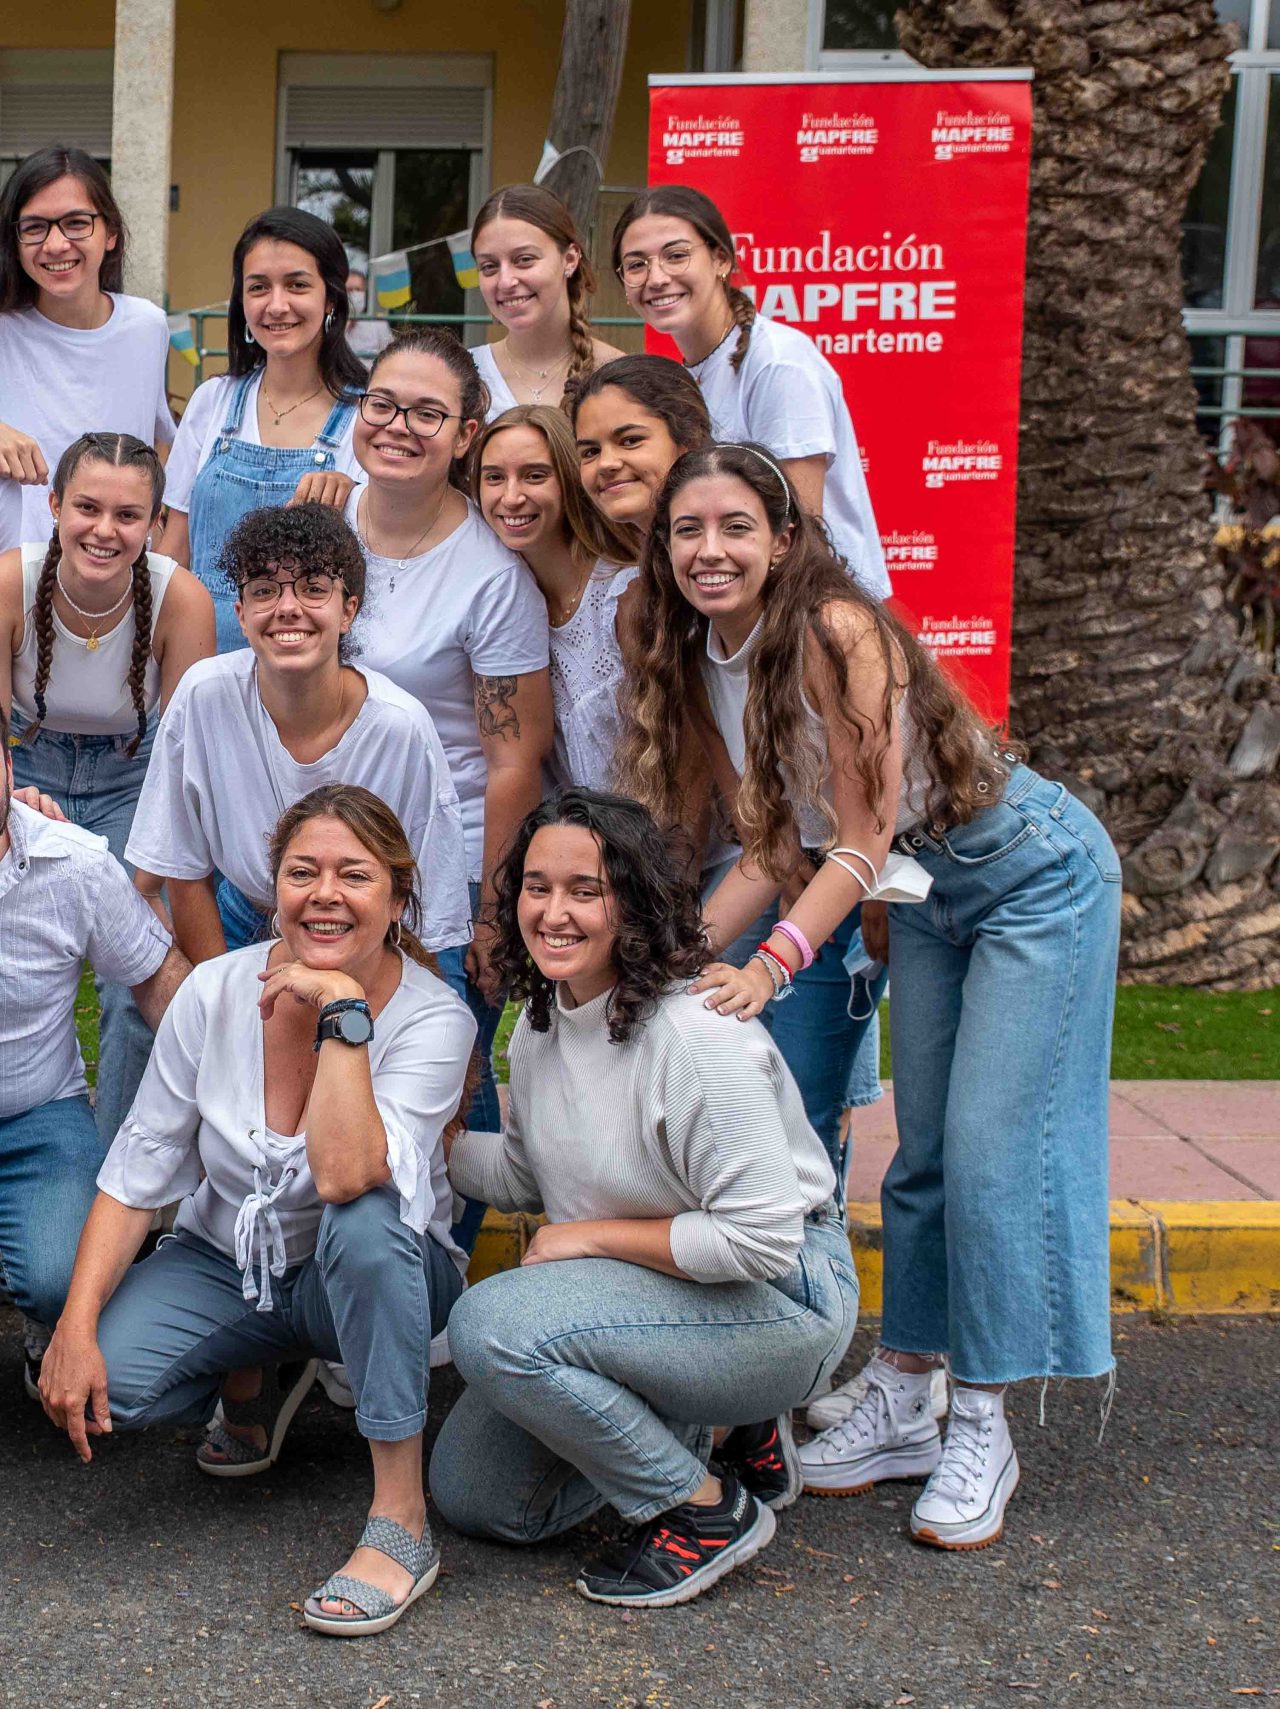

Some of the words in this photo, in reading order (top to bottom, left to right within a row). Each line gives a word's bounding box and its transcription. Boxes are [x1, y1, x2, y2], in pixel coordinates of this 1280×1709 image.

[667, 114, 740, 131] Fundación
[801, 113, 875, 129] Fundación
[936, 110, 1010, 127] Fundación
[662, 131, 744, 147] MAPFRE
[796, 128, 878, 145] MAPFRE
[931, 126, 1014, 143] MAPFRE
[731, 230, 945, 274] Fundación
[815, 328, 944, 354] narteme
[927, 439, 999, 455] Fundación
[922, 455, 1003, 472] MAPFRE
[880, 529, 935, 545] ndación
[882, 545, 938, 561] PFRE
[922, 615, 993, 631] Fundación
[917, 630, 997, 647] MAPFRE
